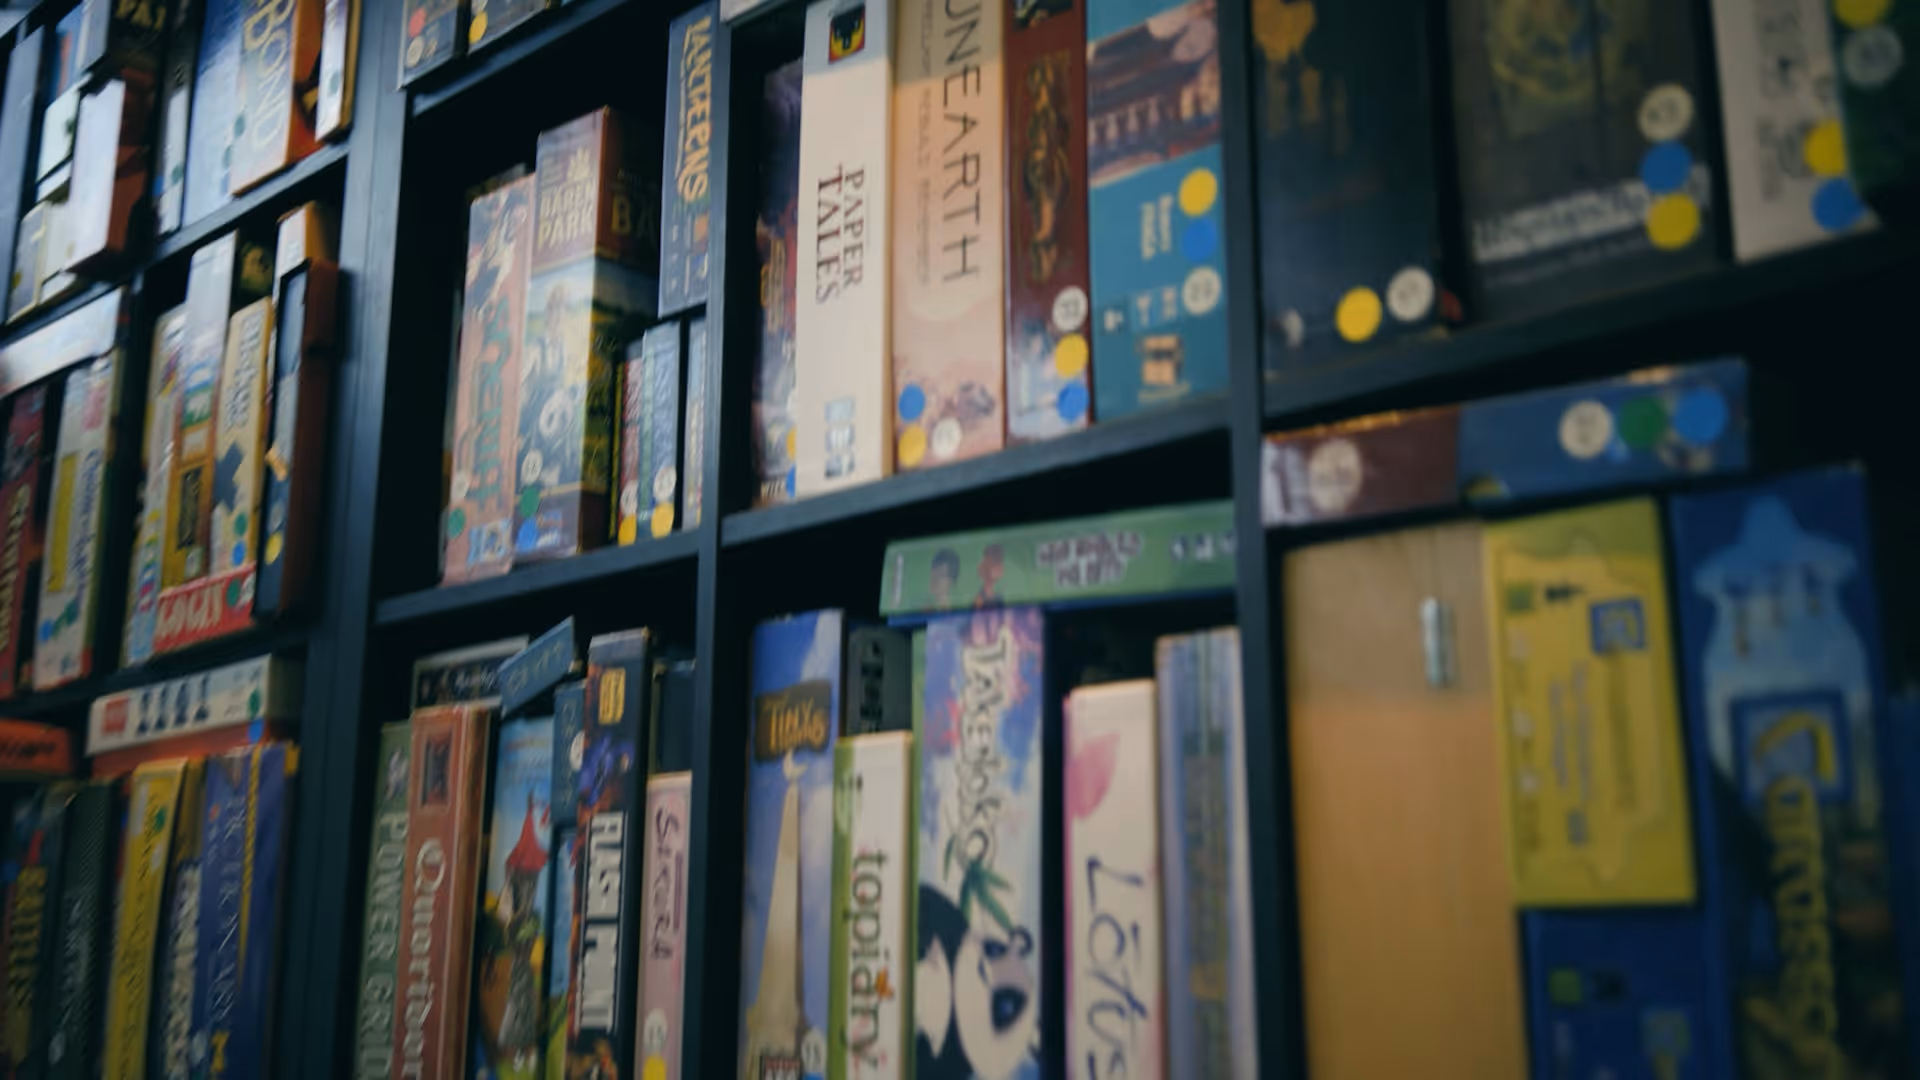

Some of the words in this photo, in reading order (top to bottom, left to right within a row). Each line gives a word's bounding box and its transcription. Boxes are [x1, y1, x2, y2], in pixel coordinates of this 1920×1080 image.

[678, 15, 713, 203] LANTERNS
[538, 199, 596, 251] PARK
[815, 163, 844, 304] TALES
[842, 166, 866, 290] PAPER
[367, 811, 409, 961] POWER
[842, 849, 889, 1068] topiary
